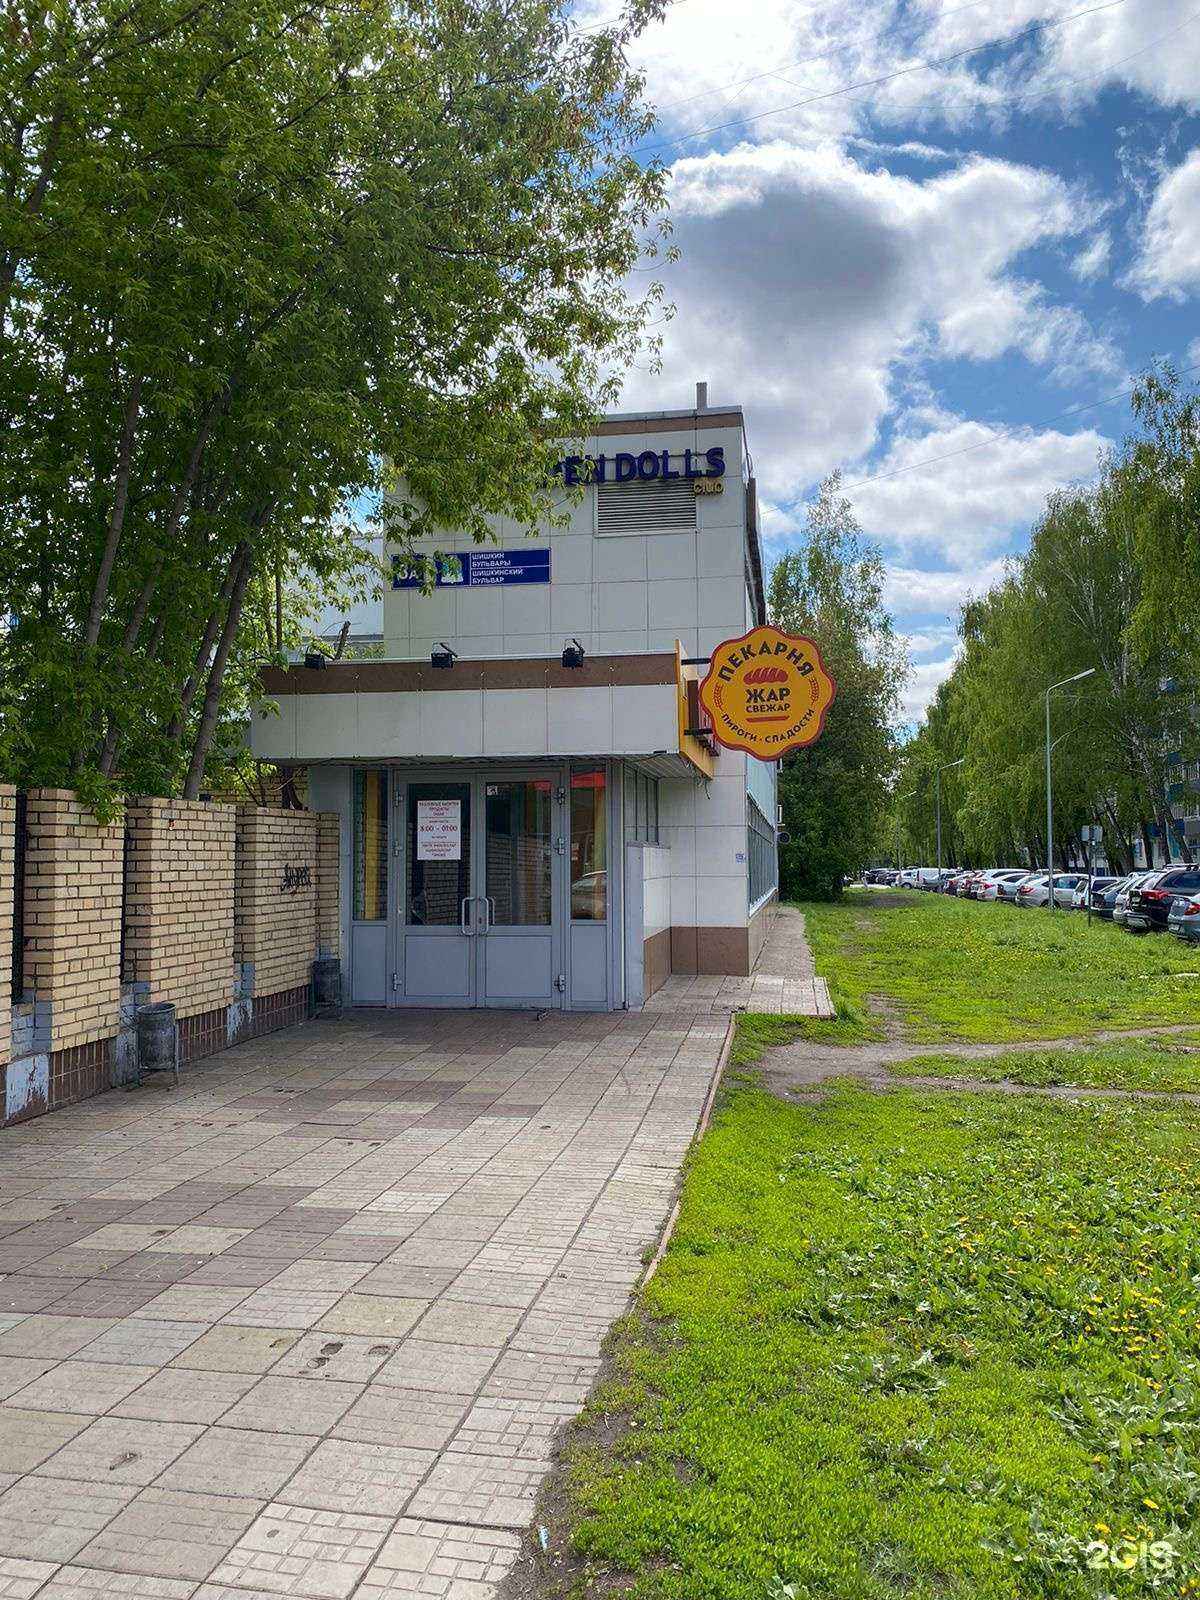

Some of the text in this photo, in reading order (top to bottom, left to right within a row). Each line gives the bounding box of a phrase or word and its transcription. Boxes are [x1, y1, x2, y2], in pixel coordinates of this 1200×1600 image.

[615, 447, 726, 482] DOLLS
[471, 560, 511, 568] БУЛЬВАРЫ
[471, 568, 523, 577] ШИШКИНСКИЙ
[471, 577, 505, 585] БУЛЬВАР
[718, 641, 814, 682] ПЕКАРНЯ
[745, 687, 791, 703] ЖАР
[745, 703, 791, 713] СВЕЖАР
[721, 708, 815, 744] ПИРОГИ СЛАДОСТИ
